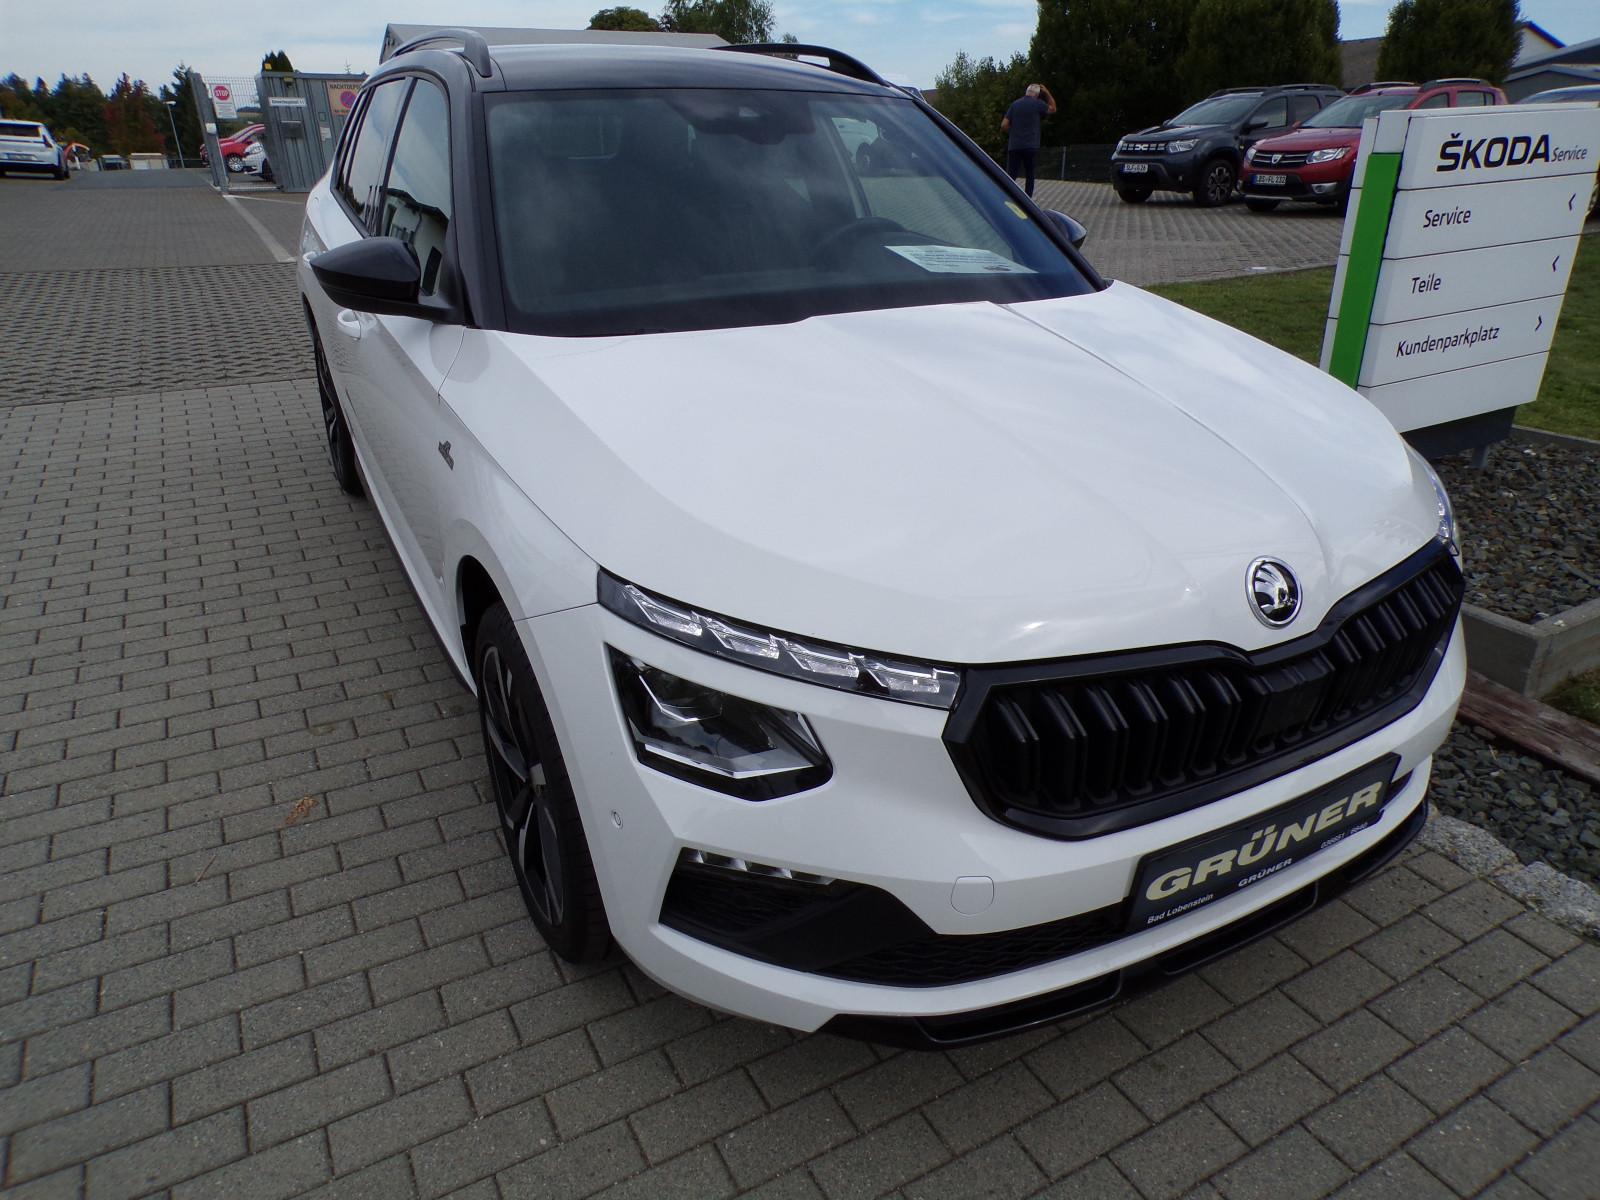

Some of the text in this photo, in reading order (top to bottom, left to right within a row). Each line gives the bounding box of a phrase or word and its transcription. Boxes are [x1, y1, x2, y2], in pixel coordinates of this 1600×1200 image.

[1436, 133, 1588, 172] ŠKODA Service
[1423, 205, 1471, 228] Service
[1411, 274, 1441, 294] Teile
[1396, 326, 1500, 357] Kundenparkplatz
[1145, 781, 1383, 901] GRÜNER
[1238, 857, 1292, 888] GRÜNER
[1147, 893, 1215, 924] Bad Lobenstein
